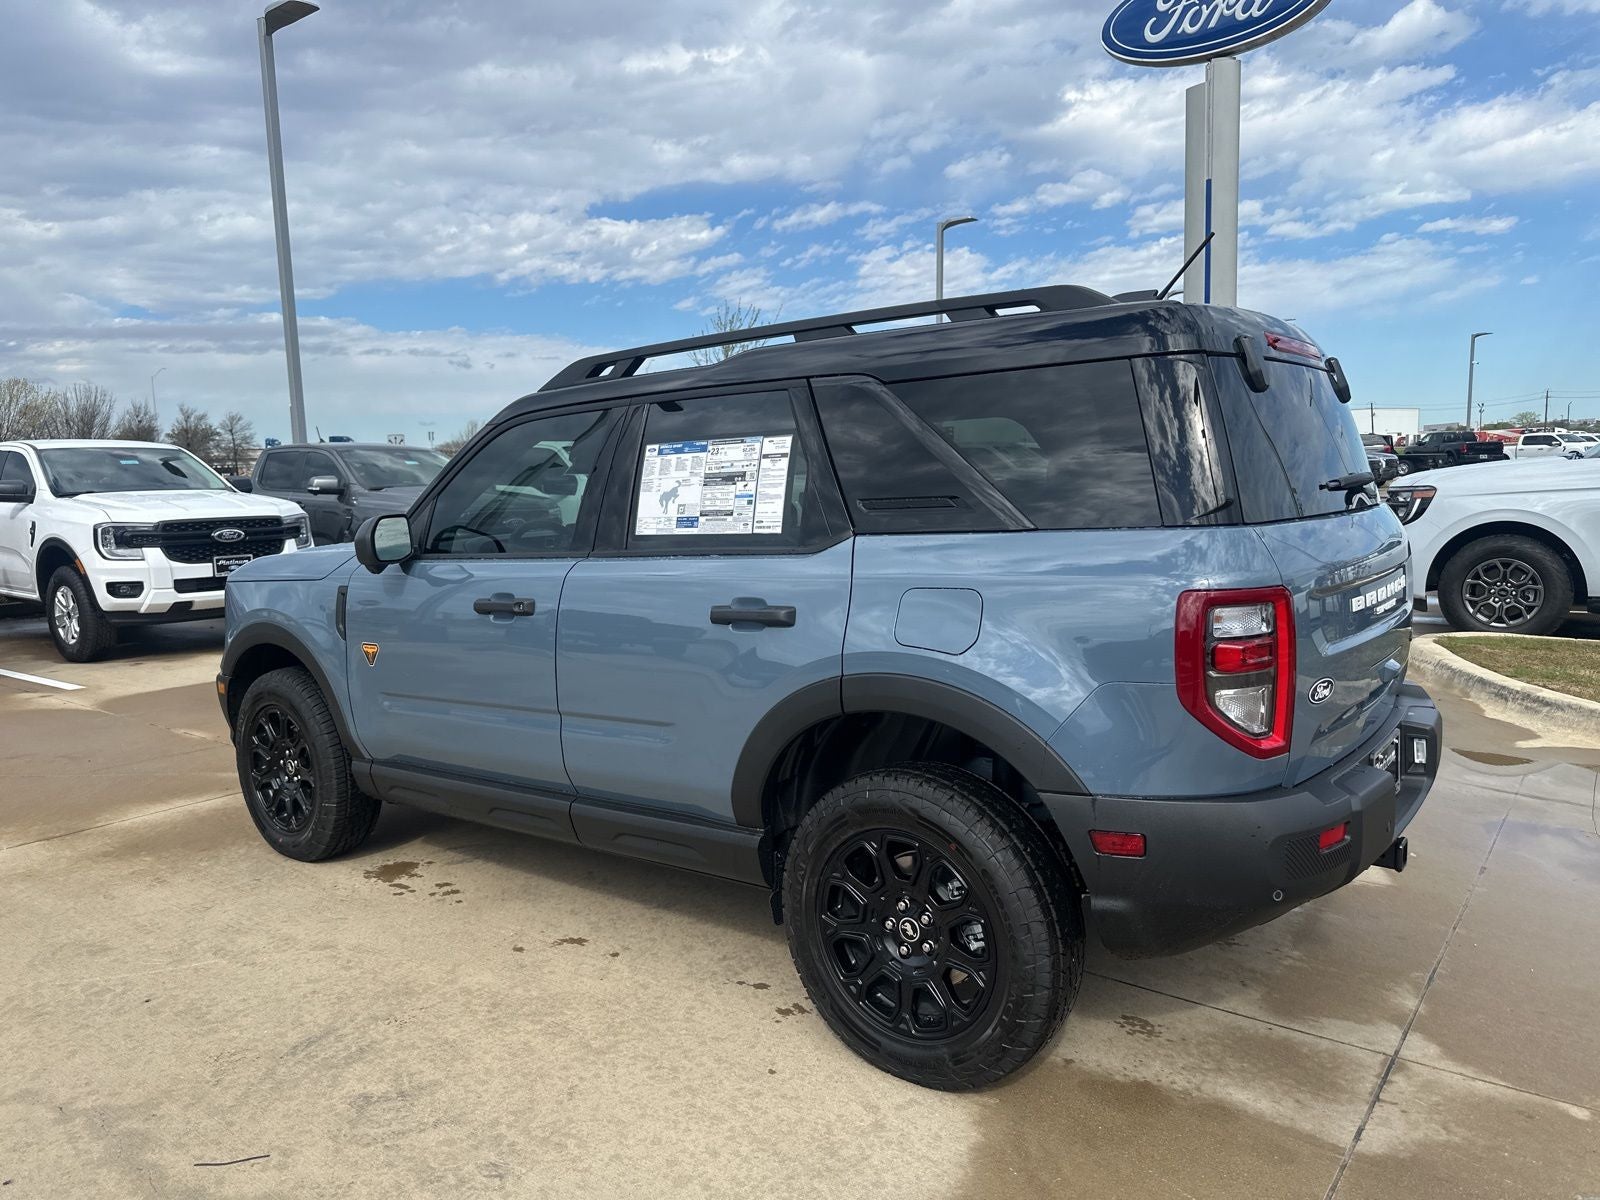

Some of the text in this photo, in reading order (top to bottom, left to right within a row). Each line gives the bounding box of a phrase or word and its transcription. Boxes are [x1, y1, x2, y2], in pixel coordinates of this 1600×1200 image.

[1143, 0, 1274, 43] Ford
[710, 447, 720, 456] 23
[1314, 682, 1332, 700] Ford
